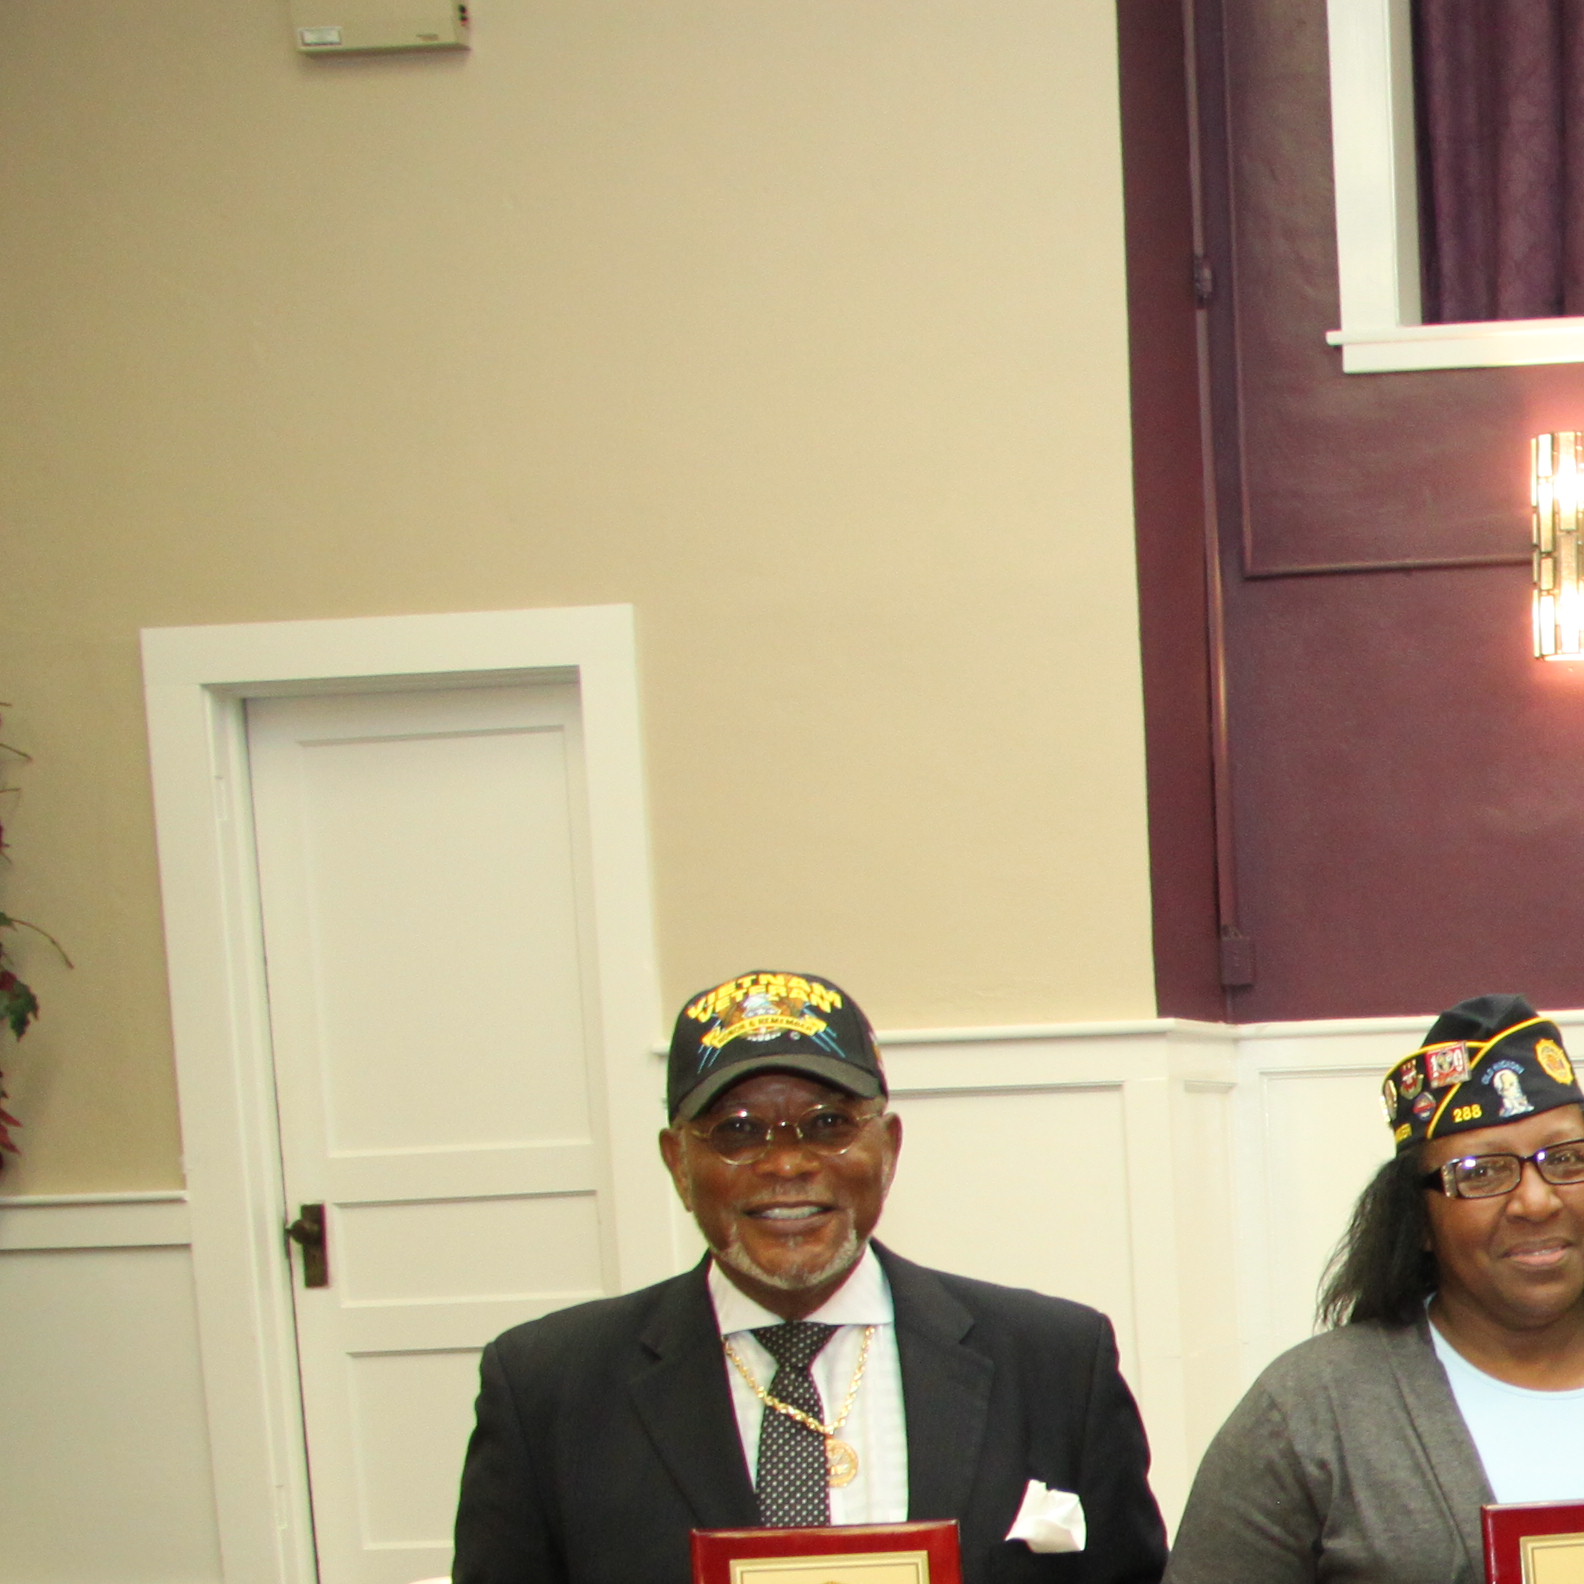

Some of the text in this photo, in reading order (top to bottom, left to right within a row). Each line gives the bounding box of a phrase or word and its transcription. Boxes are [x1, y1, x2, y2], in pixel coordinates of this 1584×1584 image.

[686, 973, 843, 1019] VIETNAM
[698, 985, 832, 1023] VETERAN
[1453, 1104, 1483, 1123] 288
